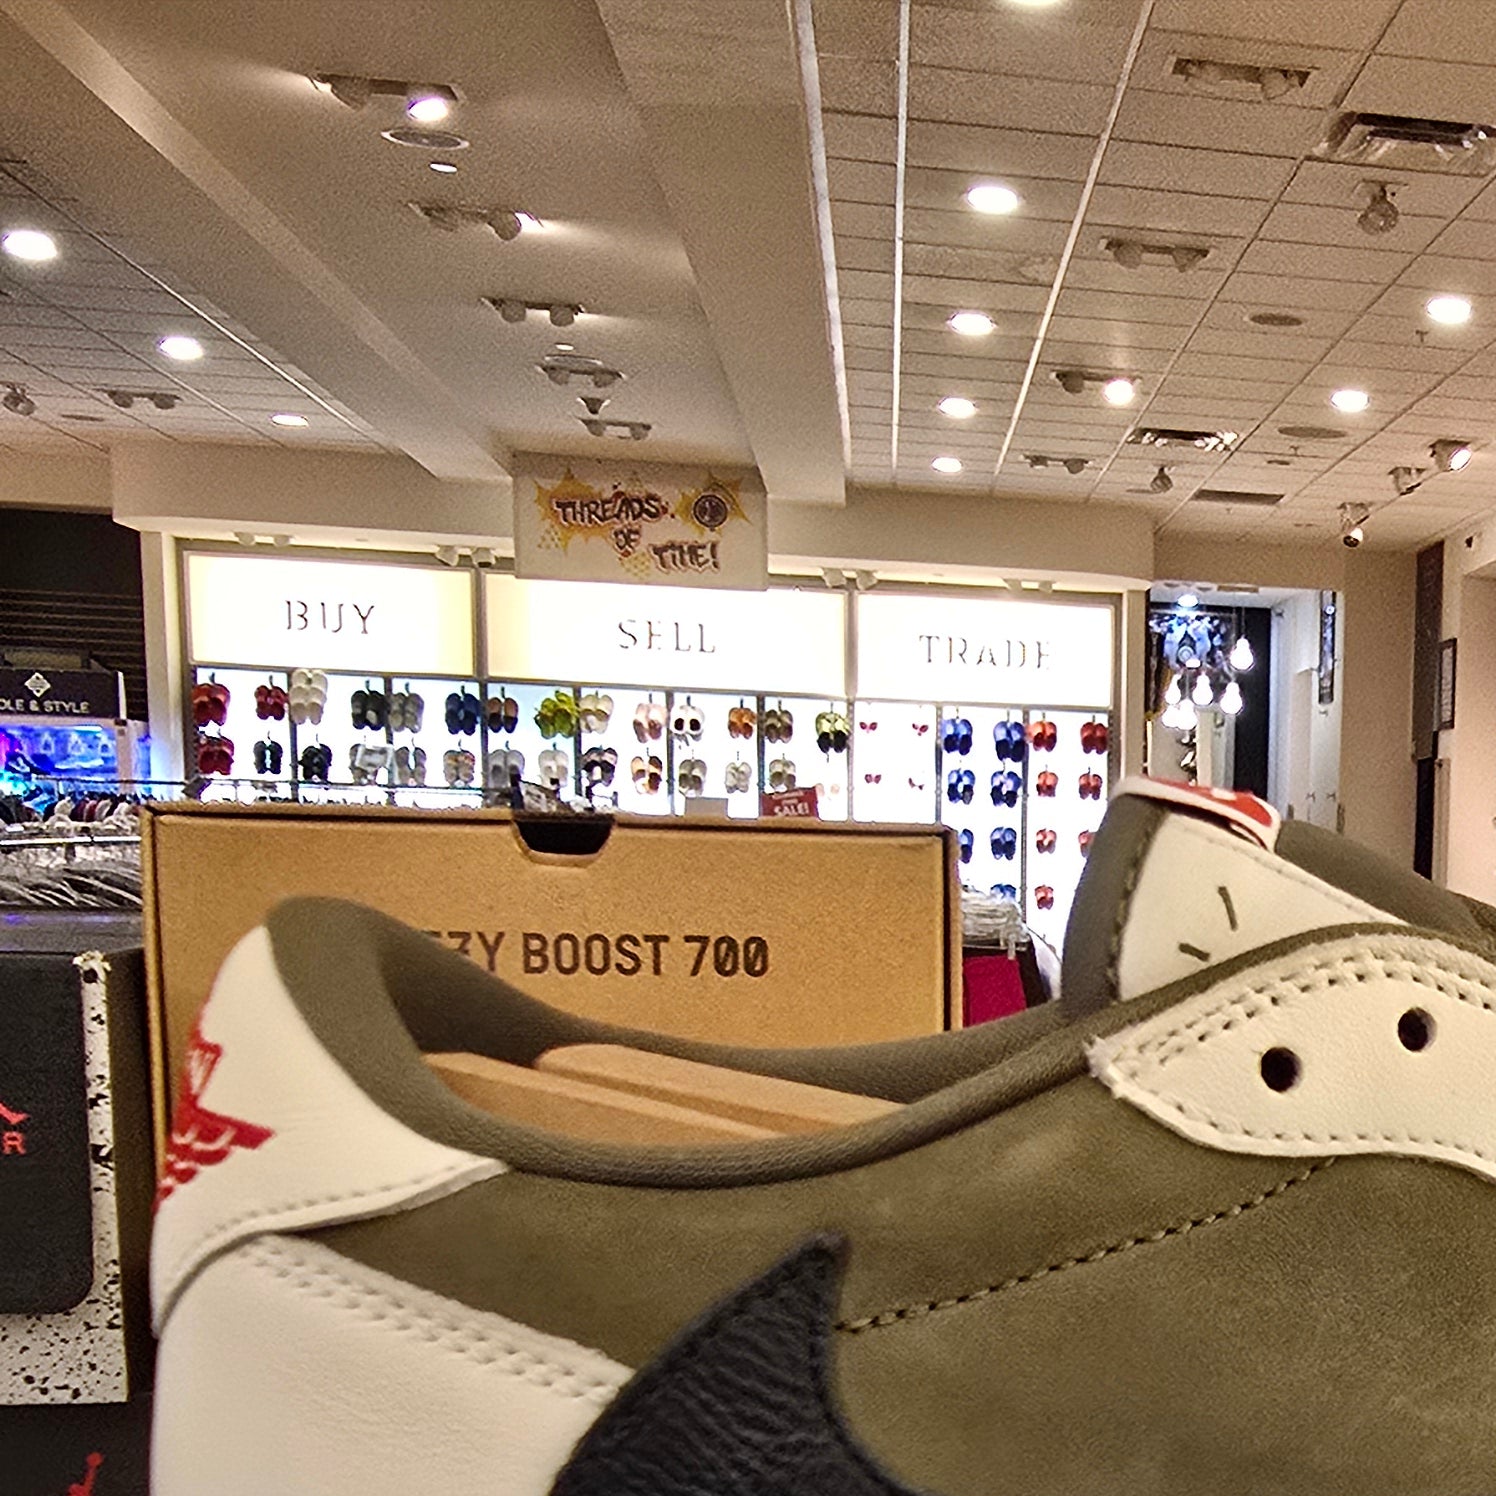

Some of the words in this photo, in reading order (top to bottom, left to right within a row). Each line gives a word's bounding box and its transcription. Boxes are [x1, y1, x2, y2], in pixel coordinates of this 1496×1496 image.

[555, 493, 660, 522] THREADS
[613, 528, 640, 550] OF
[285, 600, 375, 634] BUY
[618, 619, 716, 653] SELL
[919, 634, 1050, 670] TRADE
[43, 700, 90, 714] STYLE
[522, 933, 670, 976] BOOST
[684, 935, 769, 977] 700
